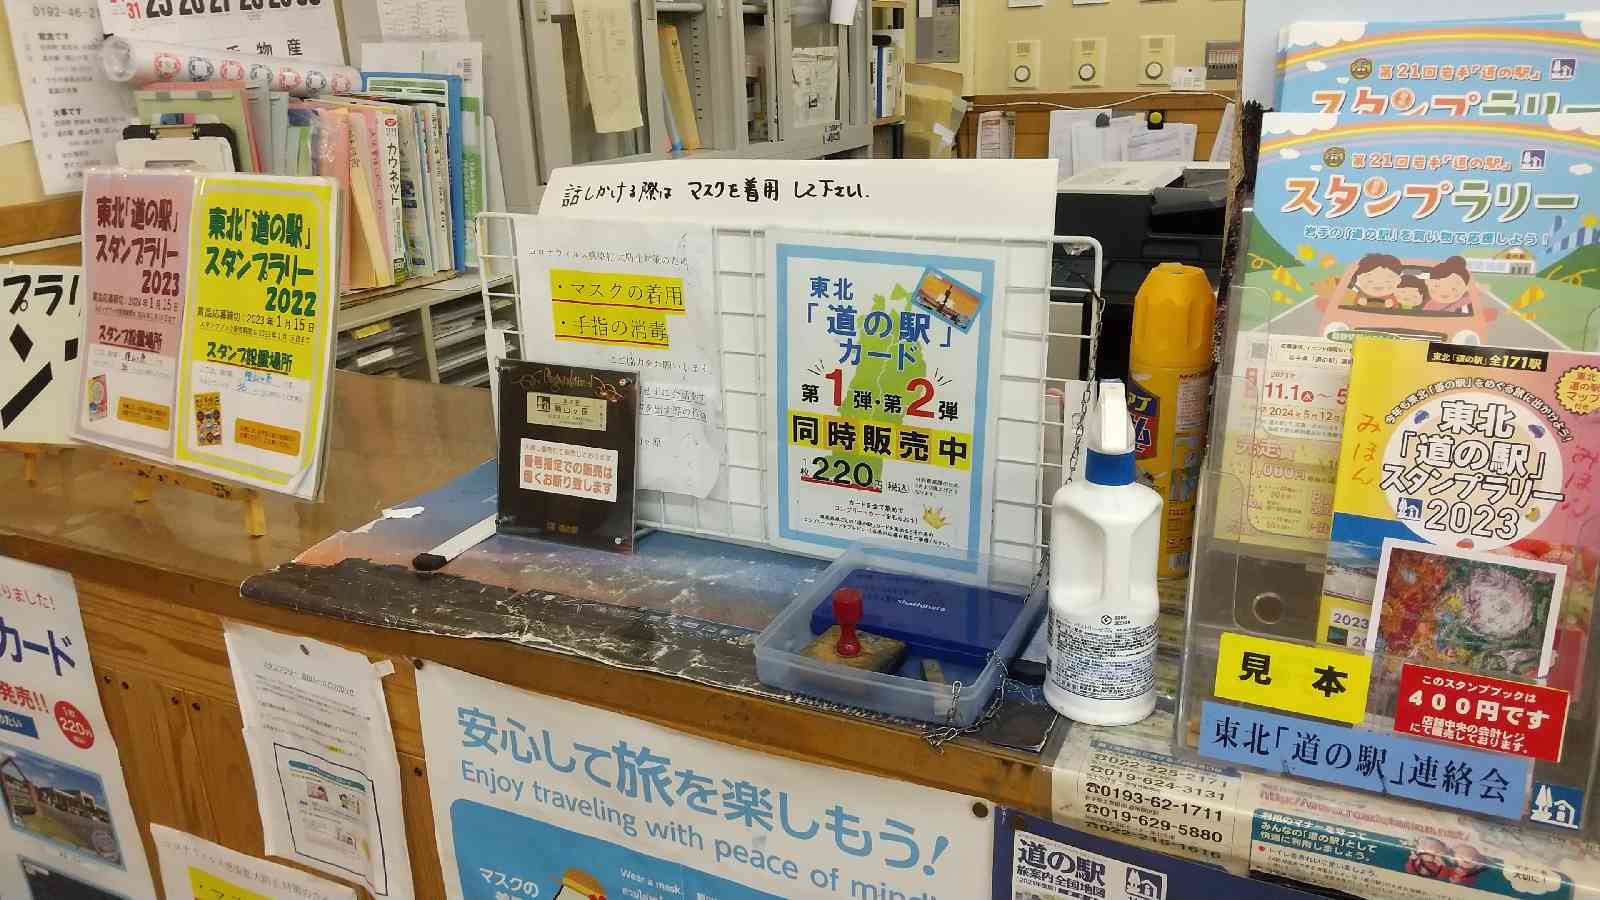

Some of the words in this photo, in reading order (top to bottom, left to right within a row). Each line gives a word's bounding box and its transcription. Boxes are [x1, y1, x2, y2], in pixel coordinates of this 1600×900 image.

[562, 180, 672, 207] 話しかける際は
[687, 177, 779, 203] マスクを着用
[1280, 174, 1580, 223] スタンプラリー
[96, 196, 180, 232] 東北「道の駅」
[208, 206, 311, 250] 東北「道の駅」
[95, 234, 179, 268] スタンプラリー
[204, 246, 314, 287] スタンプラリー
[142, 269, 180, 296] 2023
[265, 287, 317, 317] 2022
[809, 275, 854, 301] 東北
[807, 302, 952, 348] 「道の駅」
[838, 337, 918, 371] カード
[801, 368, 959, 422] 第1弾・第2弾
[793, 414, 968, 466] 同時販売中
[1439, 400, 1516, 440] 東北
[1352, 413, 1381, 486] みほん
[1400, 430, 1546, 481] 「道の駅」
[1380, 463, 1566, 508] スタンプラリー
[1425, 498, 1520, 540] 2023
[1407, 689, 1551, 730] 400円です
[1421, 674, 1537, 704] このスタンプブックは
[1212, 715, 1511, 804] 東北「道の駅」連絡会
[456, 706, 950, 877] 安心して旅を楽しもう!
[1100, 785, 1224, 823] 0193-62-1711
[461, 759, 525, 799] Enjoy
[532, 781, 638, 837] traveling
[645, 819, 704, 851] with
[713, 837, 799, 880] peace
[809, 866, 840, 892] of
[1099, 806, 1224, 844] 019-629-5880
[478, 867, 540, 898] マスクの
[1017, 838, 1106, 887] 道の駅
